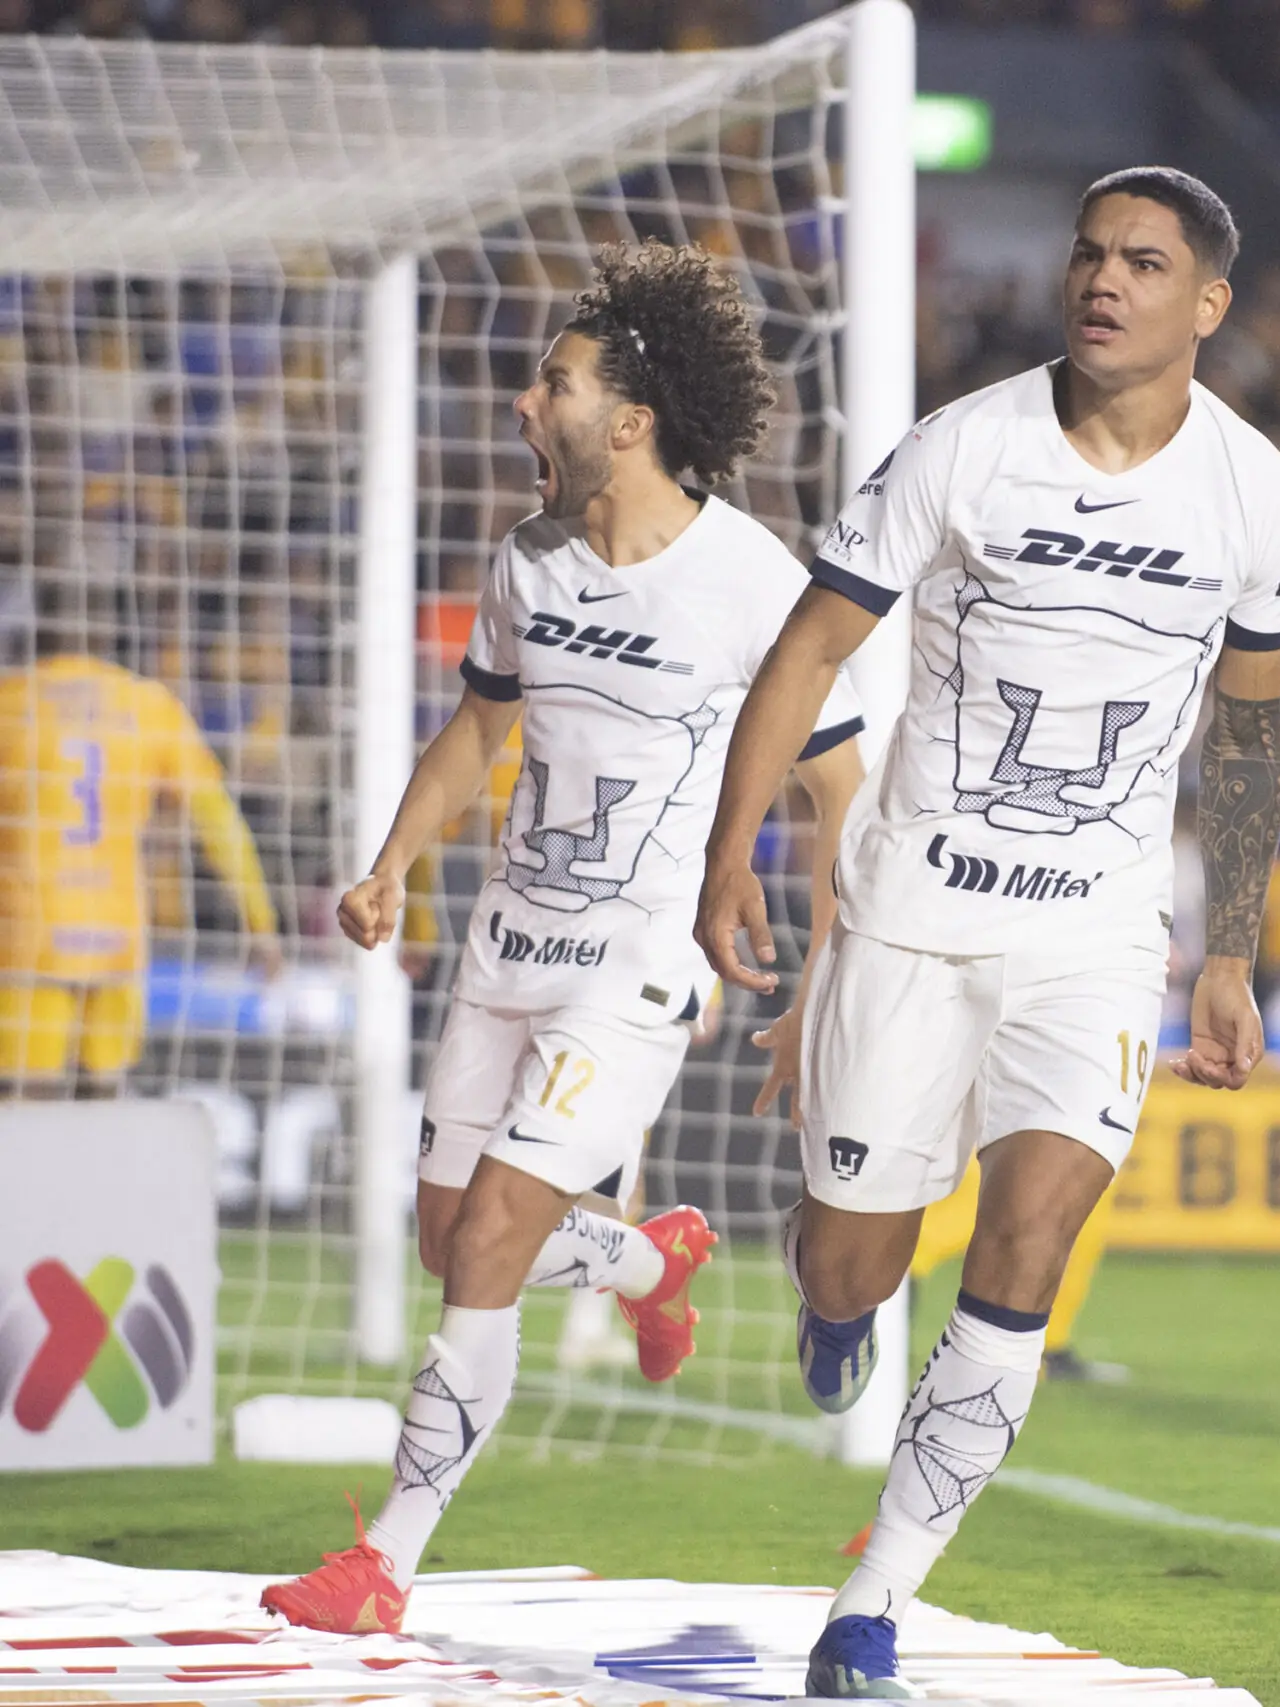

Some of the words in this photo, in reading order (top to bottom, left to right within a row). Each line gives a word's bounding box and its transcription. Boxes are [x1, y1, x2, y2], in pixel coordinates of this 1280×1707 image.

[827, 519, 865, 549] NP
[1015, 528, 1192, 587] DHL
[524, 611, 664, 669] DHL
[1002, 864, 1104, 901] Mifel
[538, 1050, 597, 1119] 12
[1117, 1029, 1148, 1104] 19
